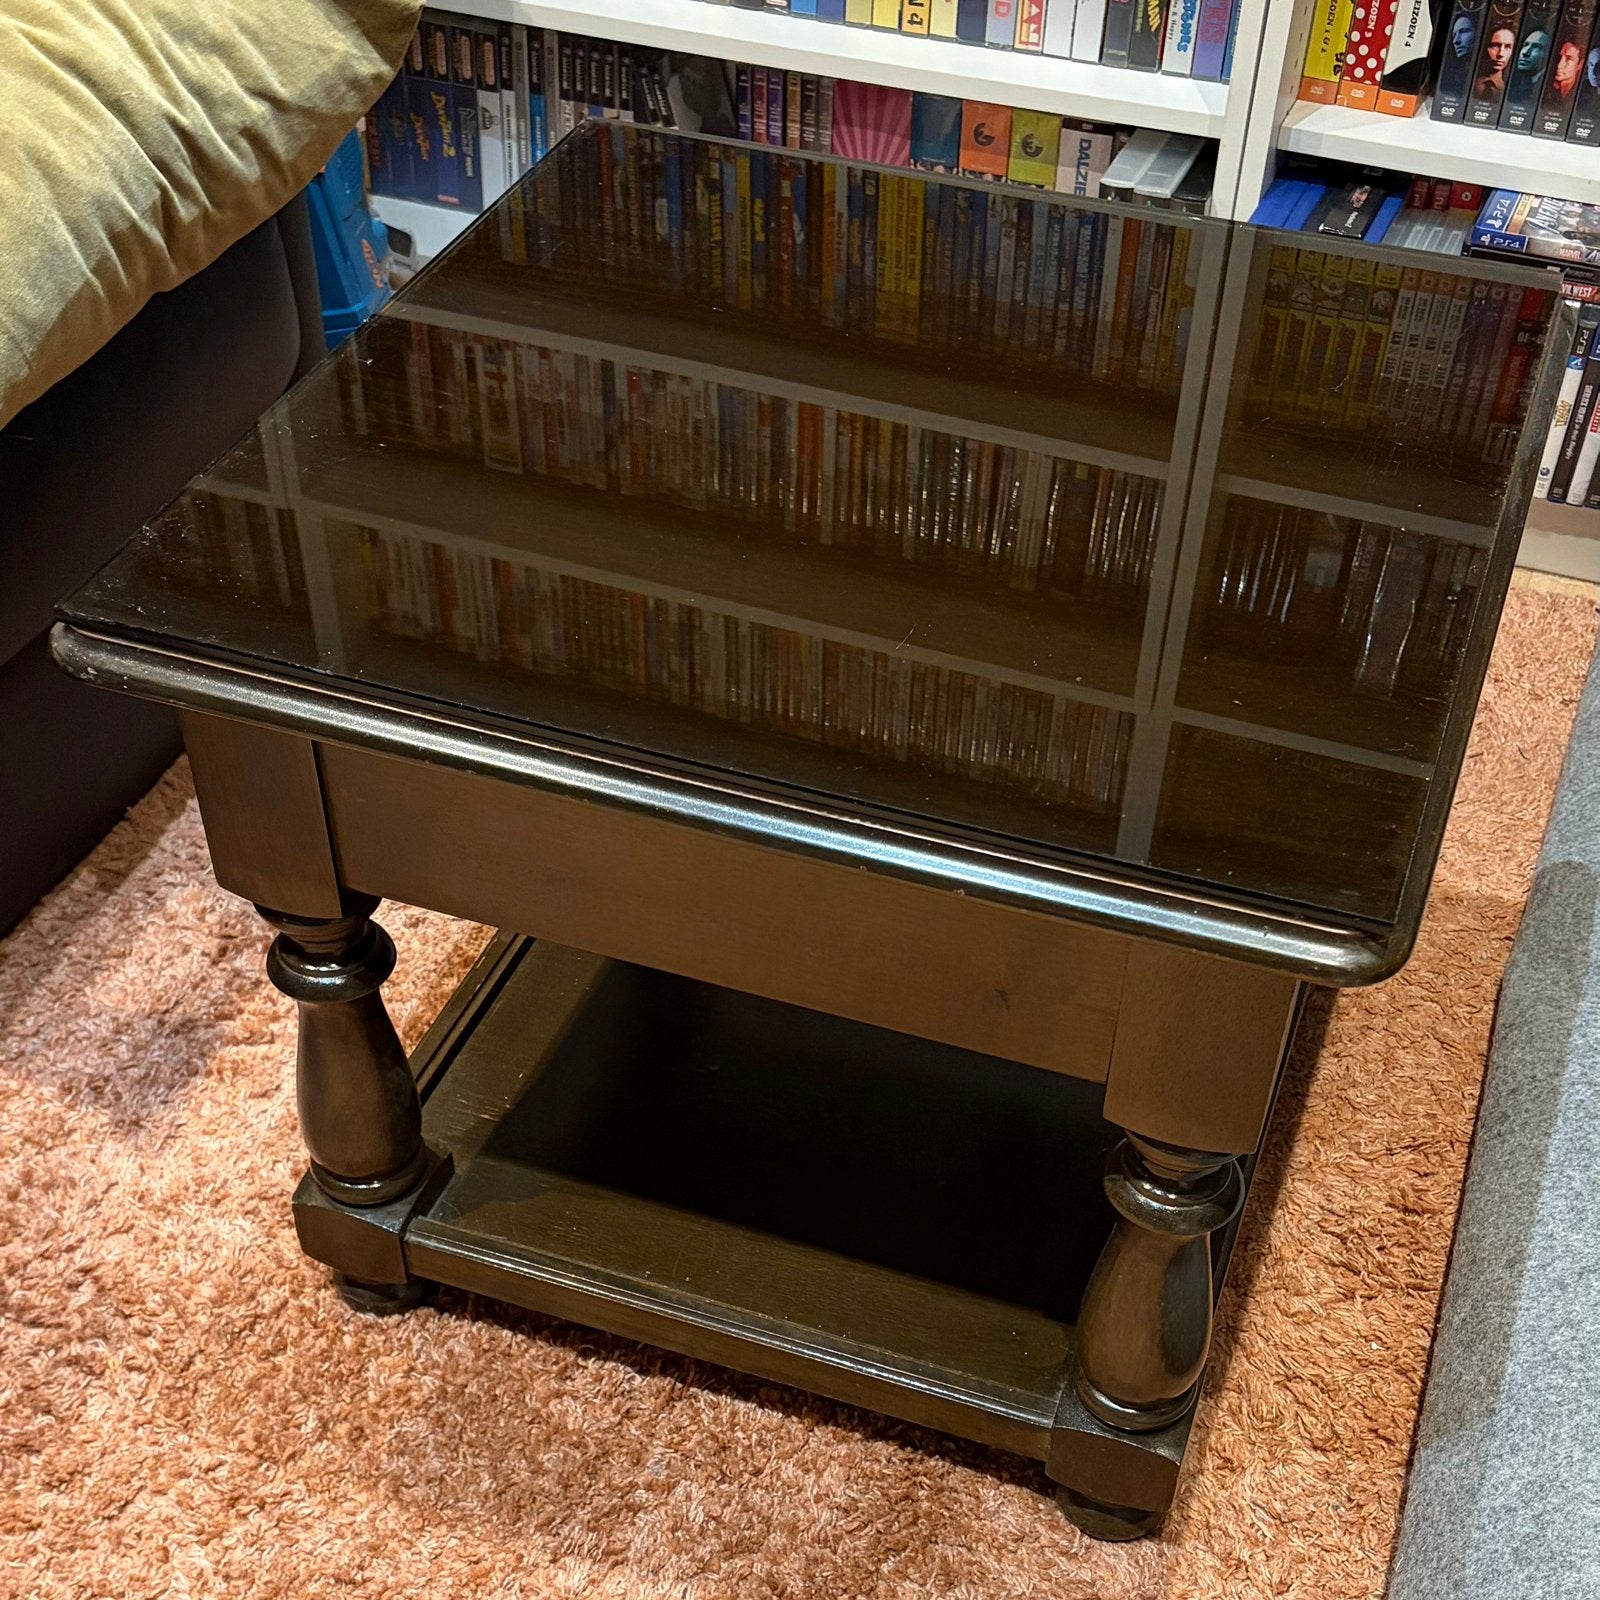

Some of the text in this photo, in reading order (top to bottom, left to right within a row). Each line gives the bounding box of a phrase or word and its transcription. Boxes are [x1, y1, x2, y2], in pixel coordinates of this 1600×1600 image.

[1492, 199, 1511, 219] PS4
[1493, 237, 1520, 248] PS4
[1576, 329, 1590, 355] PS3
